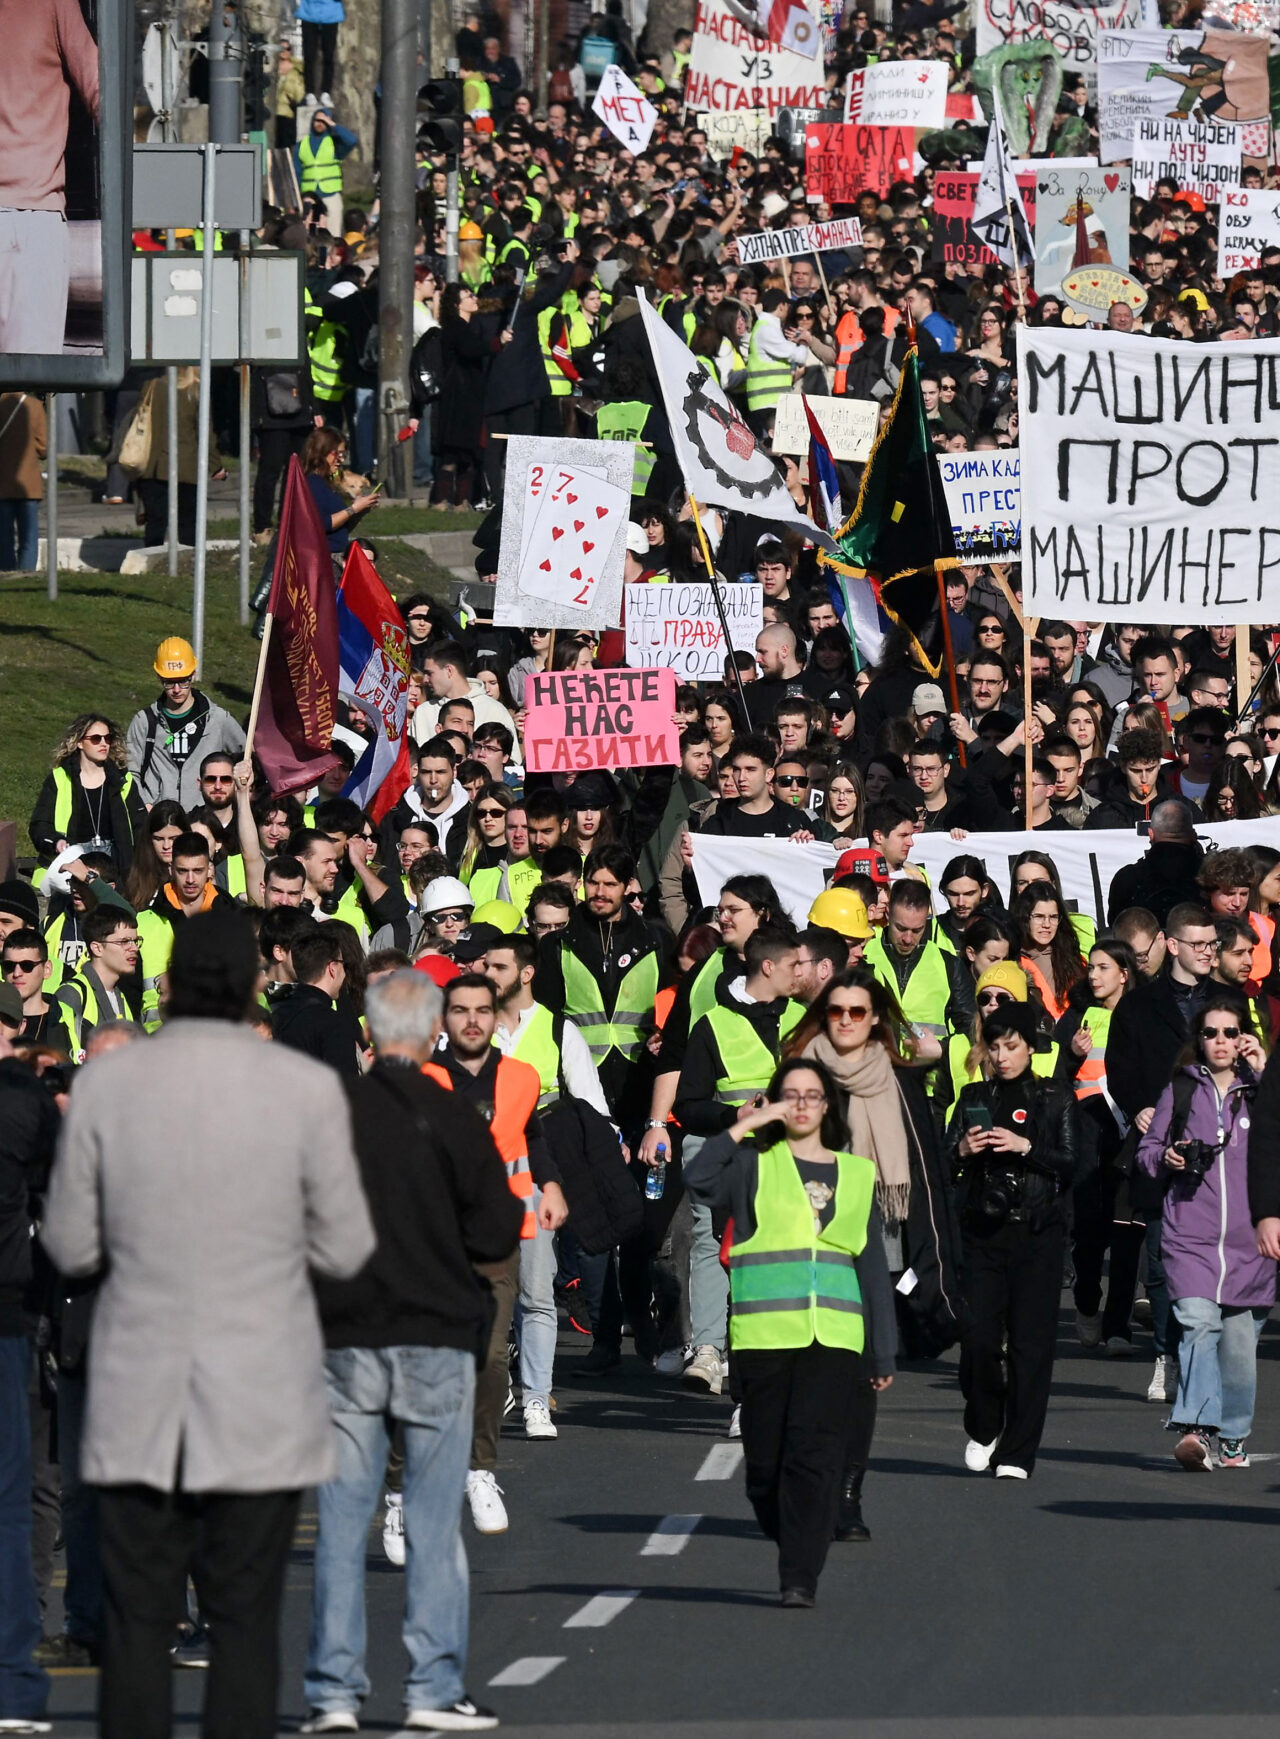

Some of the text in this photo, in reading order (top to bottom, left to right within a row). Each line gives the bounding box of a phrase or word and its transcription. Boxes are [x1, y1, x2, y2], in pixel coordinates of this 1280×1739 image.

[741, 54, 773, 80] УЗ
[824, 124, 844, 153] 24
[856, 126, 905, 157] САТА
[1141, 122, 1159, 141] НИ
[1164, 124, 1184, 143] НА
[1169, 143, 1207, 163] АУТУ
[1134, 160, 1154, 179] НИ
[1159, 162, 1186, 183] ПОД
[1226, 193, 1248, 207] КО
[1226, 214, 1252, 228] ОВУ
[1224, 236, 1268, 253] ДРАМУ
[1225, 254, 1263, 270] РЕЖ
[531, 467, 543, 488] 2
[556, 471, 575, 493] 7
[943, 460, 989, 482] ЗИМА
[629, 586, 760, 619] НЕПОЗНАВАЊЕ
[533, 670, 659, 706] НЕЋЕТЕ
[564, 704, 634, 737] НАС
[532, 734, 667, 771] ГАЗИТИ
